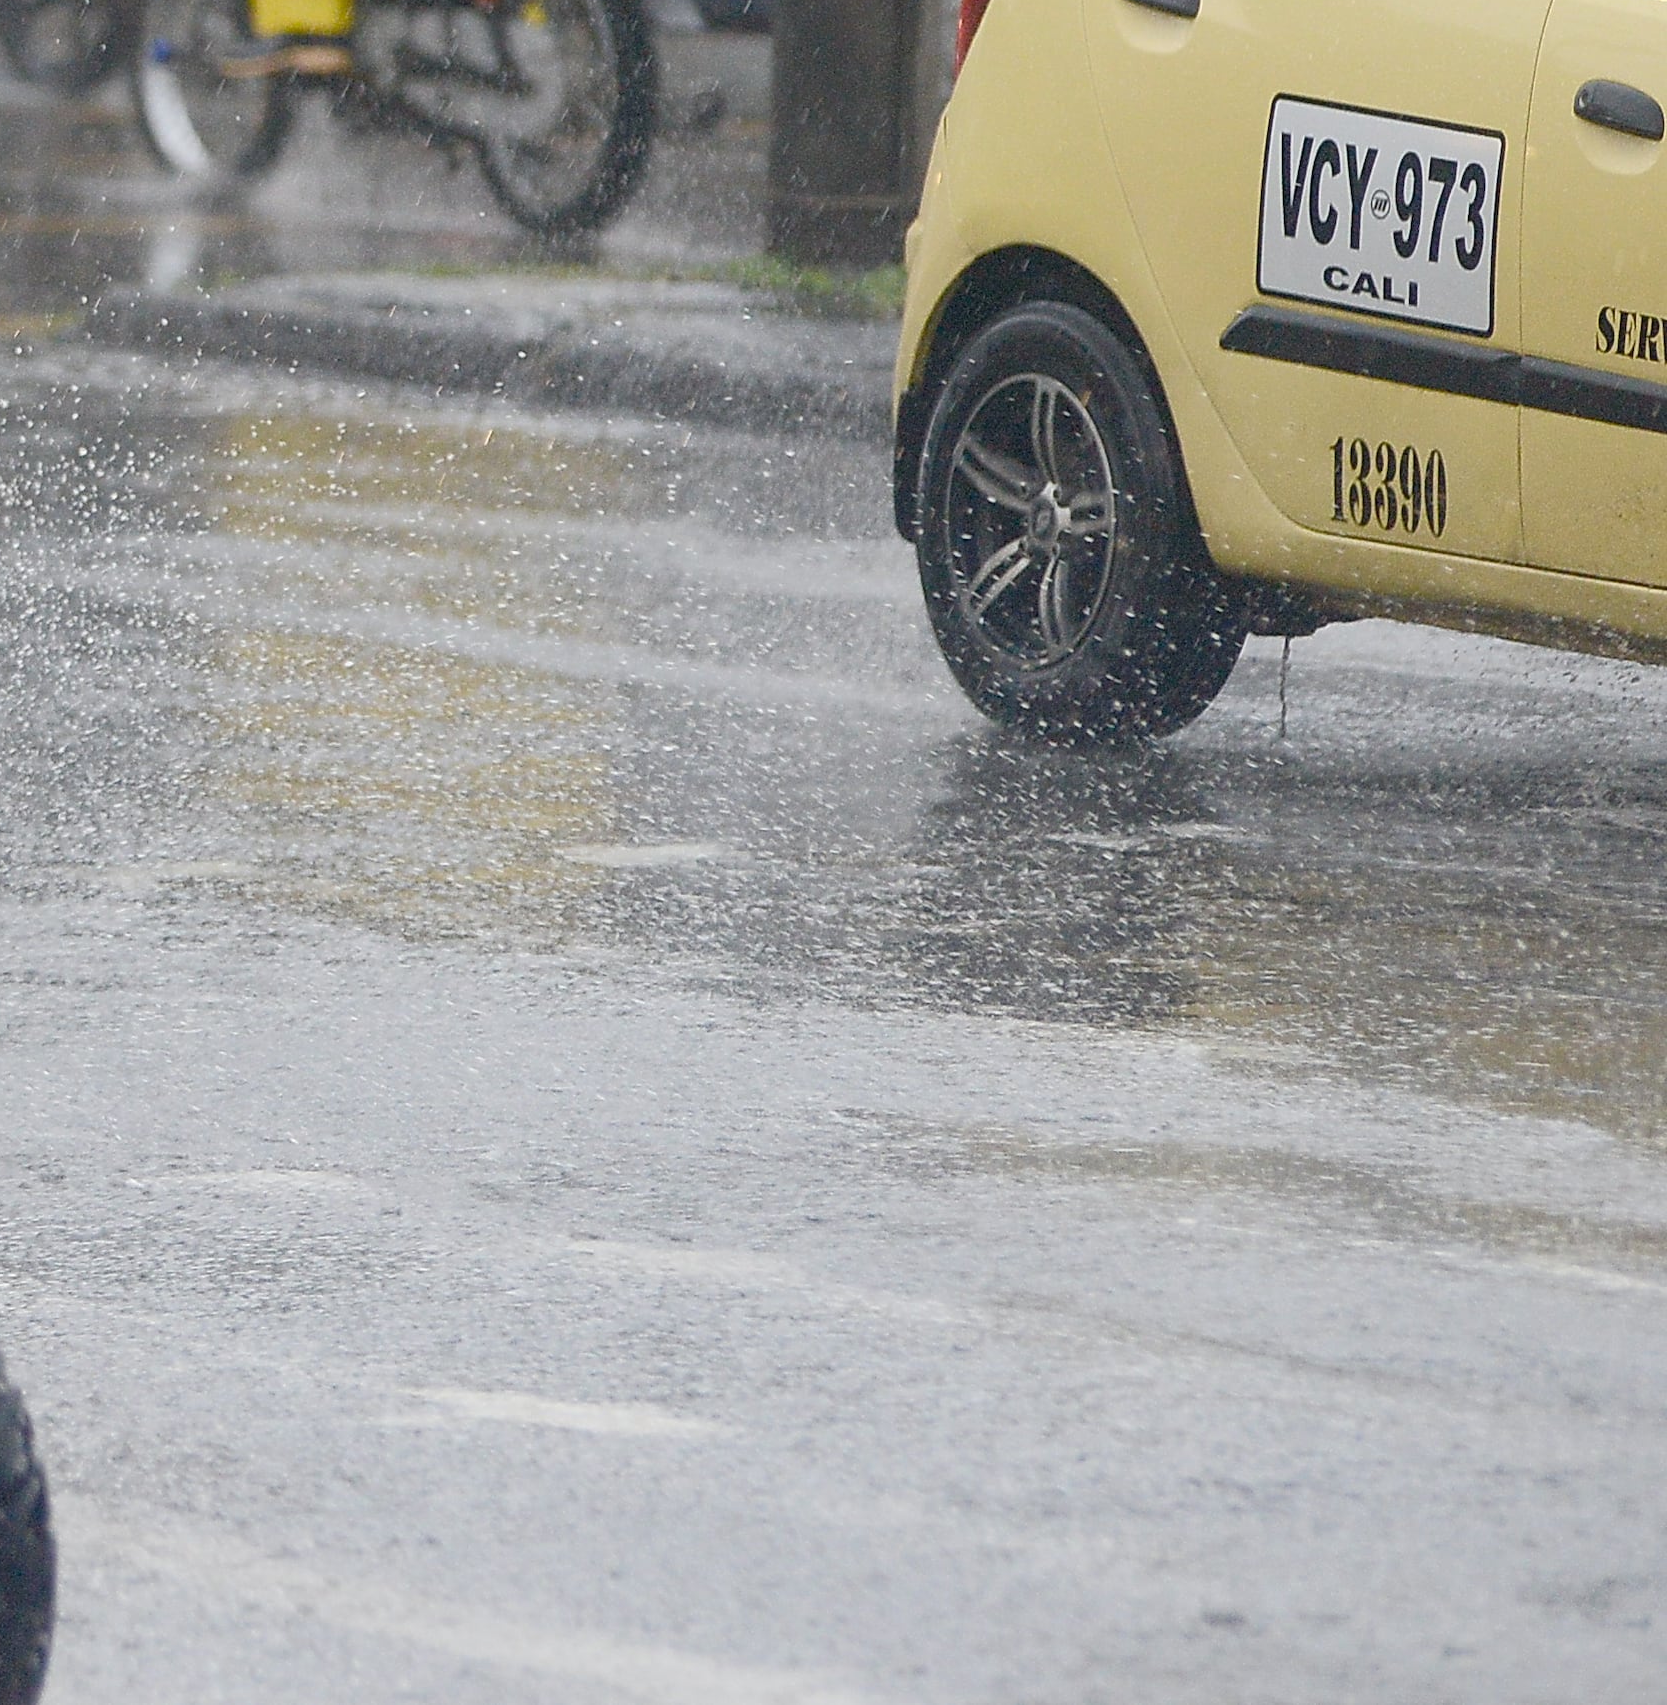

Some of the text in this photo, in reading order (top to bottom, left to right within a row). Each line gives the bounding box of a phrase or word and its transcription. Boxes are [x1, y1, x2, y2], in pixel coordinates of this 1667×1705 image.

[1280, 132, 1487, 271] VCY 973
[1322, 265, 1419, 308] CALI
[1596, 306, 1667, 365] SER
[1329, 435, 1448, 538] 13390
